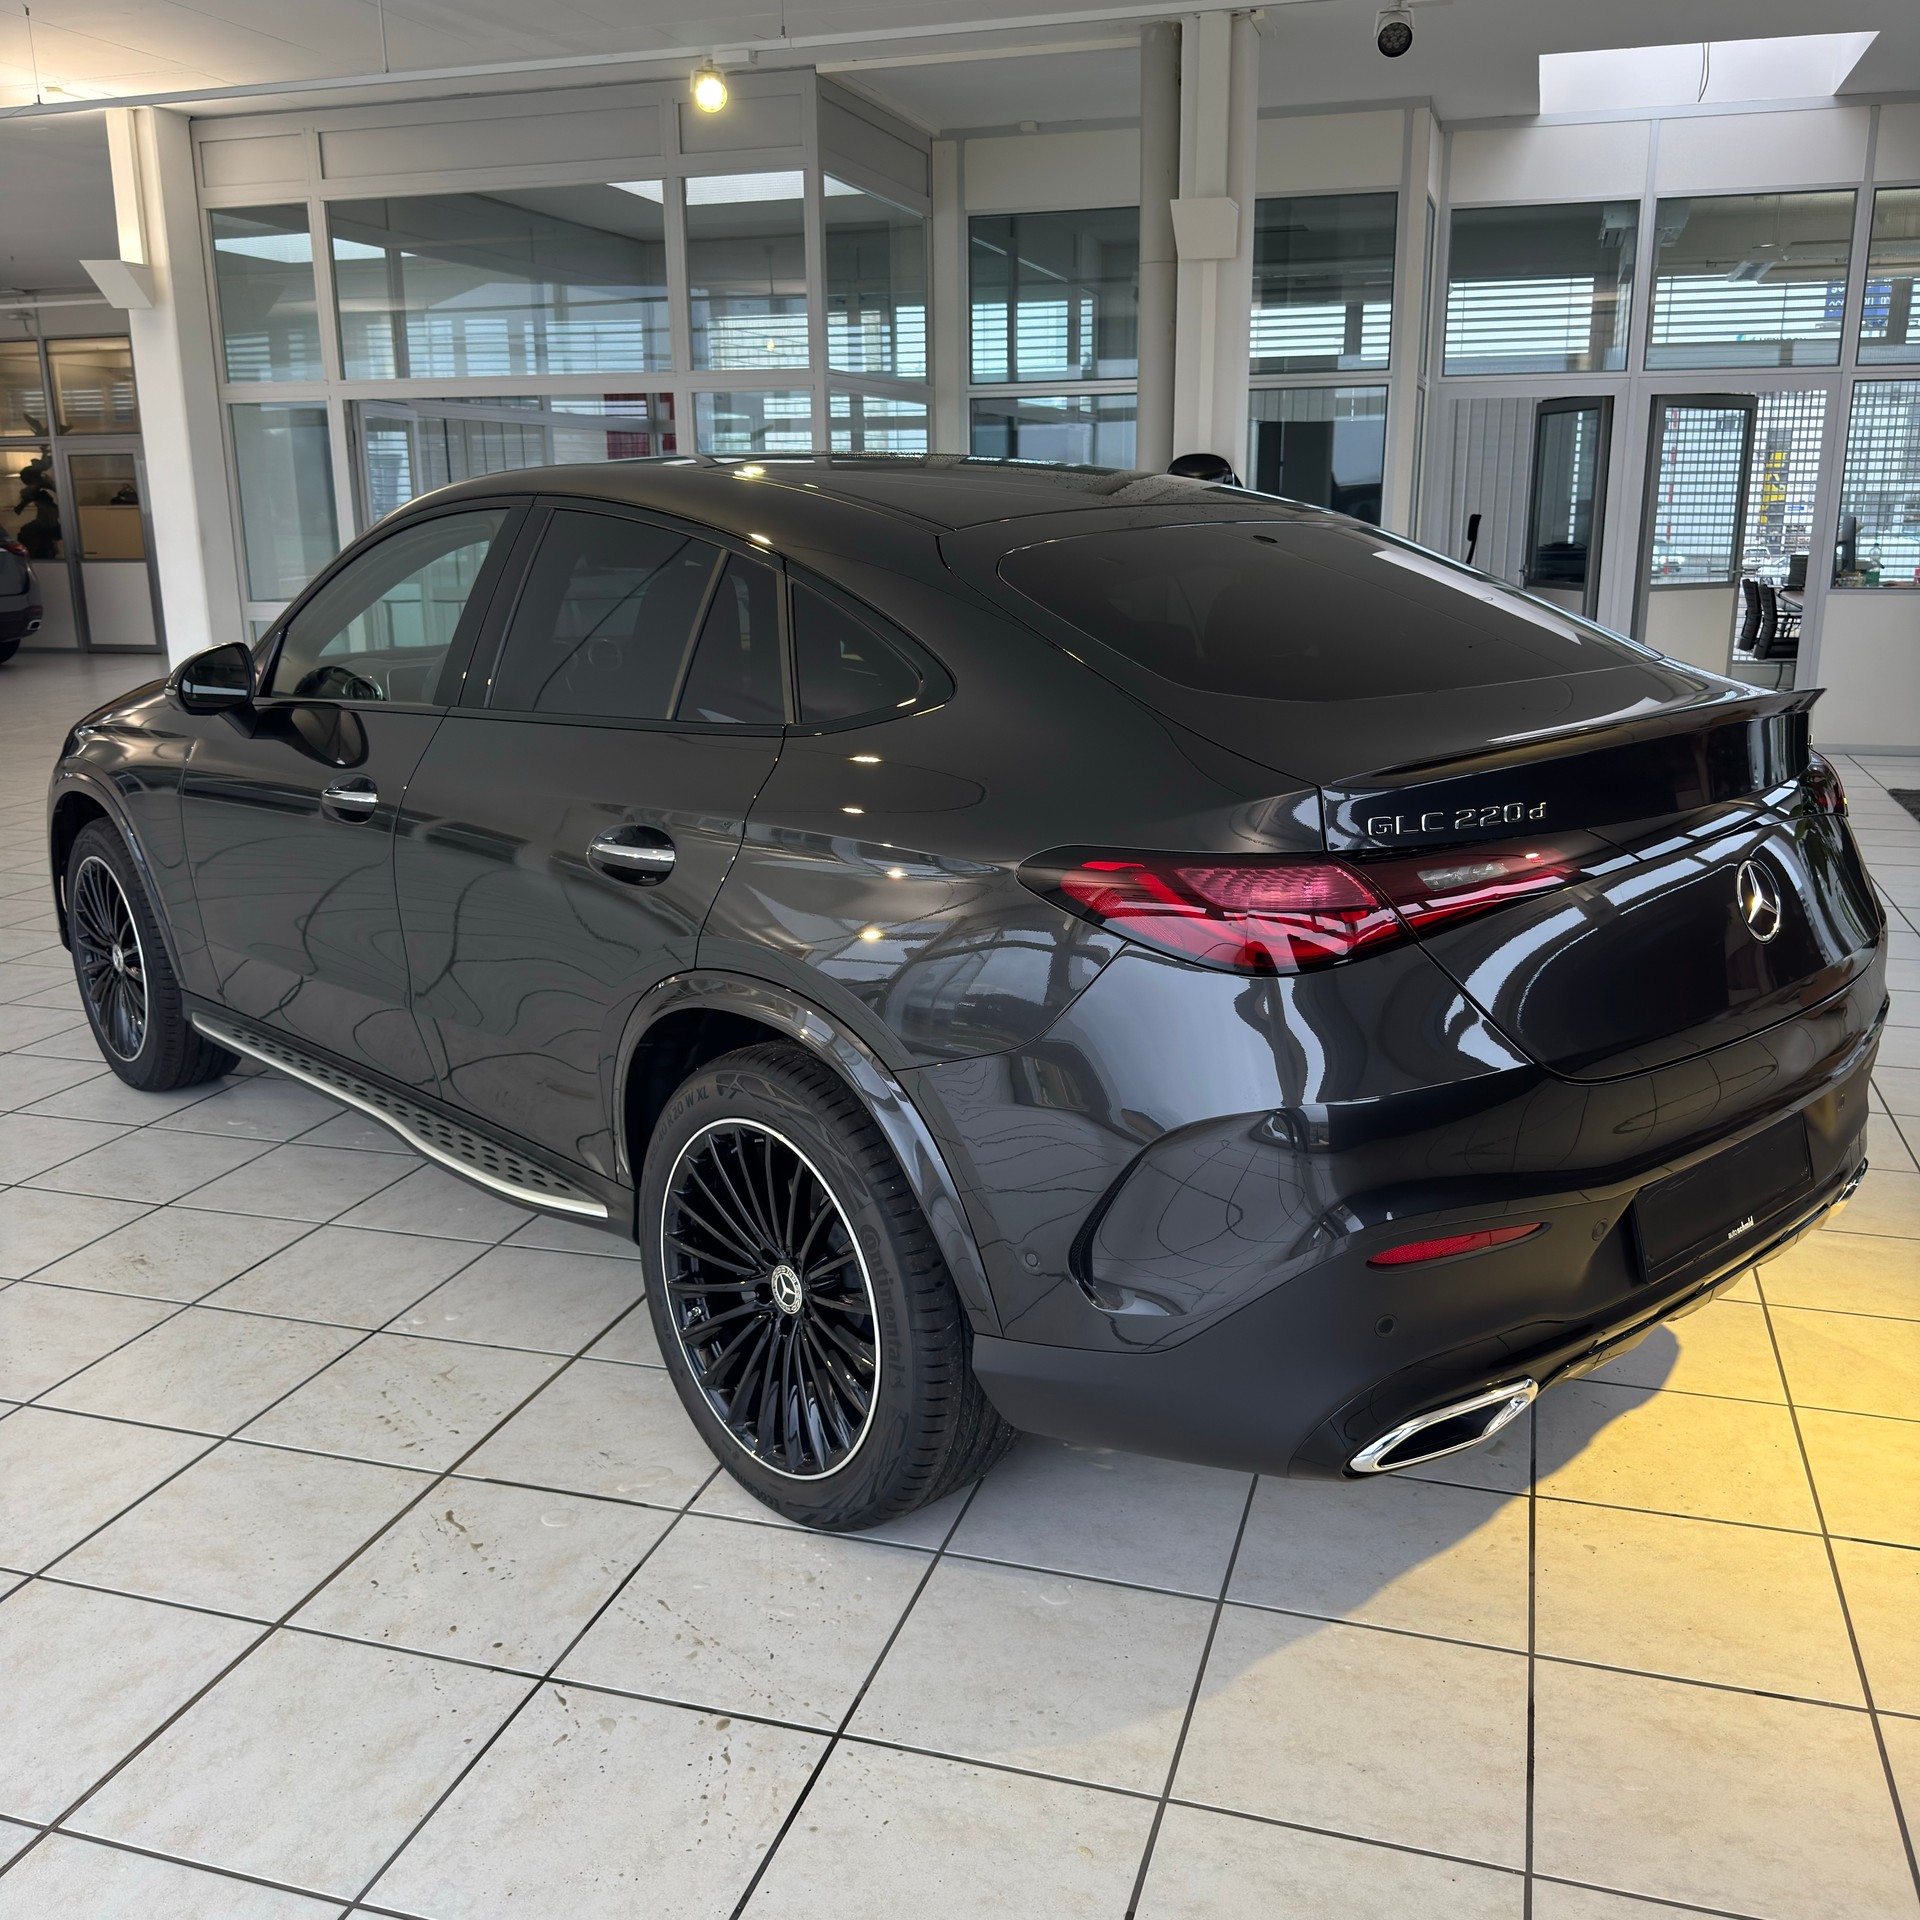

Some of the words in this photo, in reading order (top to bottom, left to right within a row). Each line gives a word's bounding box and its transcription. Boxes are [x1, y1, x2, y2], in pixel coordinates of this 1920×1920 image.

[1367, 811, 1444, 837] GLC
[696, 1085, 710, 1102] XL
[859, 1224, 906, 1374] Continental
